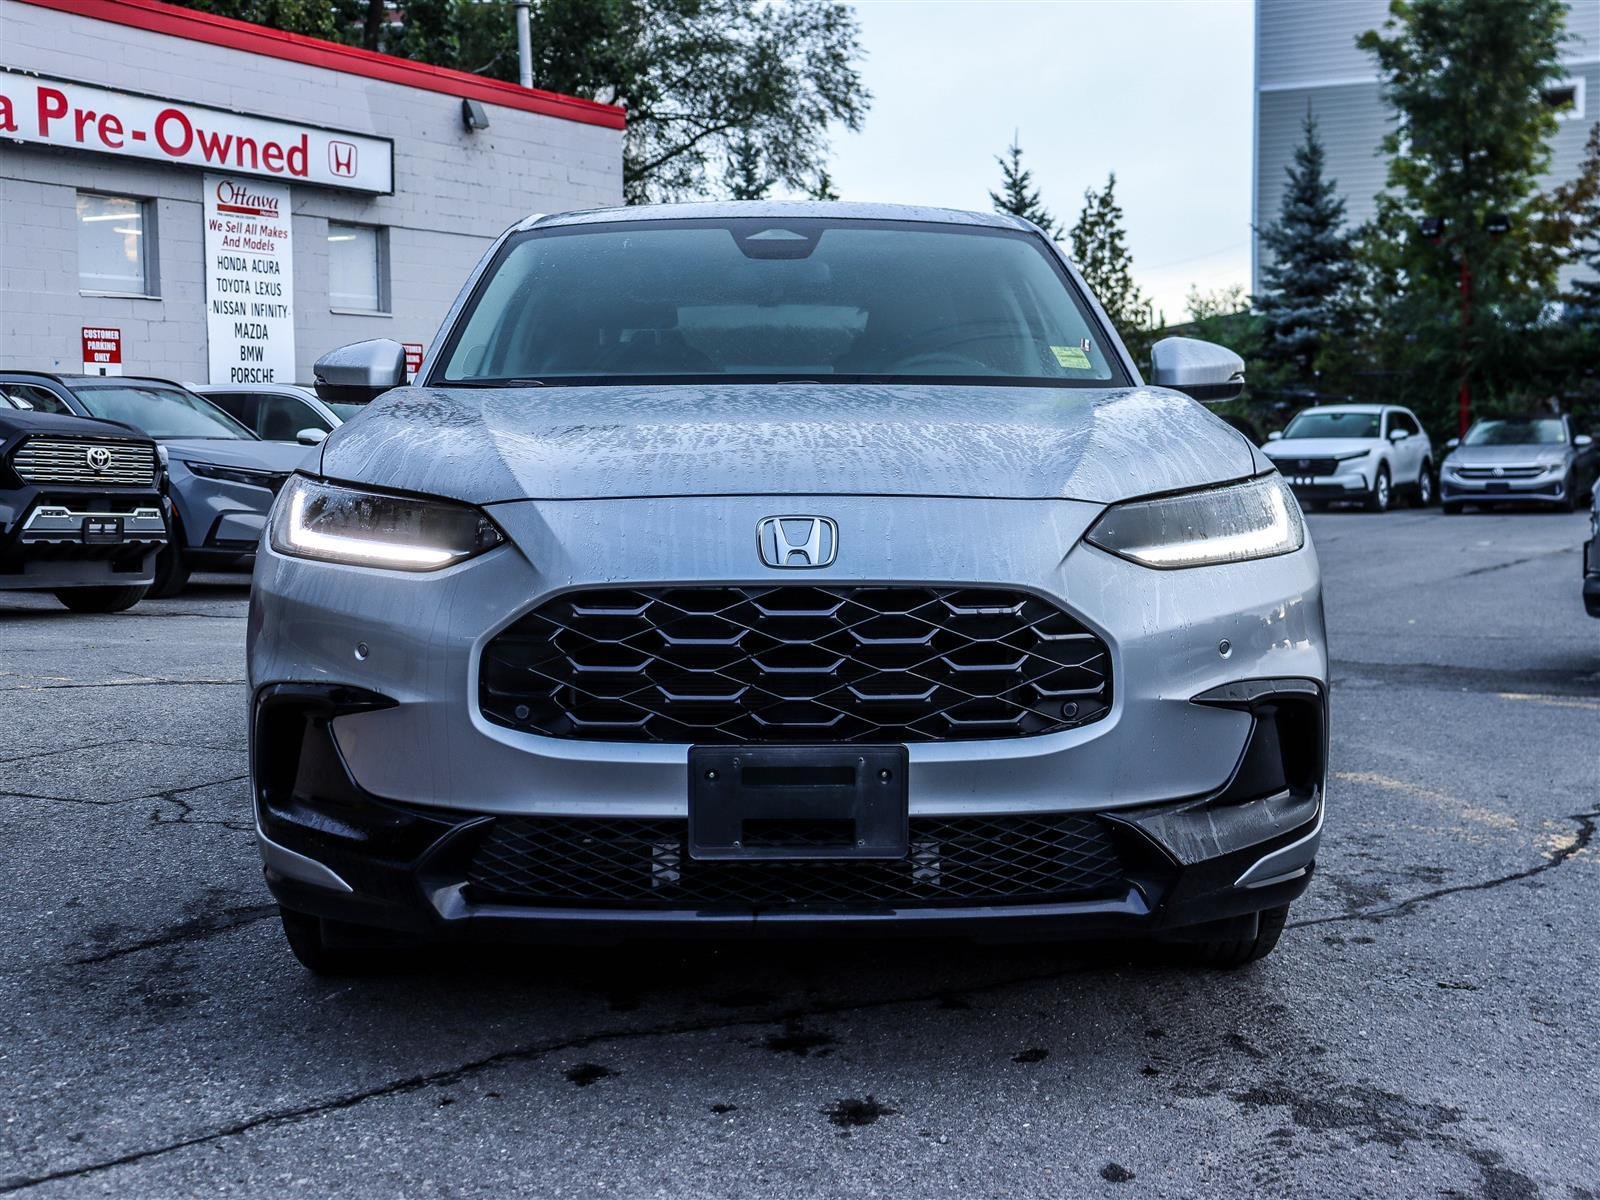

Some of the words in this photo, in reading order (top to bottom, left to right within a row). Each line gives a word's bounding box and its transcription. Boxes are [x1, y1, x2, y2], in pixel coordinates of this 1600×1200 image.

[37, 86, 308, 177] Pre-Owned
[216, 180, 279, 209] Ottawa
[209, 219, 223, 231] We
[225, 221, 243, 234] Sell
[244, 223, 257, 236] All
[259, 225, 288, 239] Makes
[222, 235, 241, 248] And
[242, 237, 275, 252] Models
[217, 255, 248, 272] HONDA
[251, 258, 281, 275] ACURA
[216, 277, 251, 294] TOYOTA
[254, 281, 282, 297] LEXUS
[212, 299, 247, 316] NISSAN
[250, 302, 288, 319] INFINITY
[83, 329, 120, 340] CUSTOMER
[234, 322, 269, 341] MAZDA
[87, 340, 117, 351] PARKING
[239, 345, 264, 362] BMW
[94, 352, 111, 362] ONLY
[230, 366, 274, 384] PORSCHE
